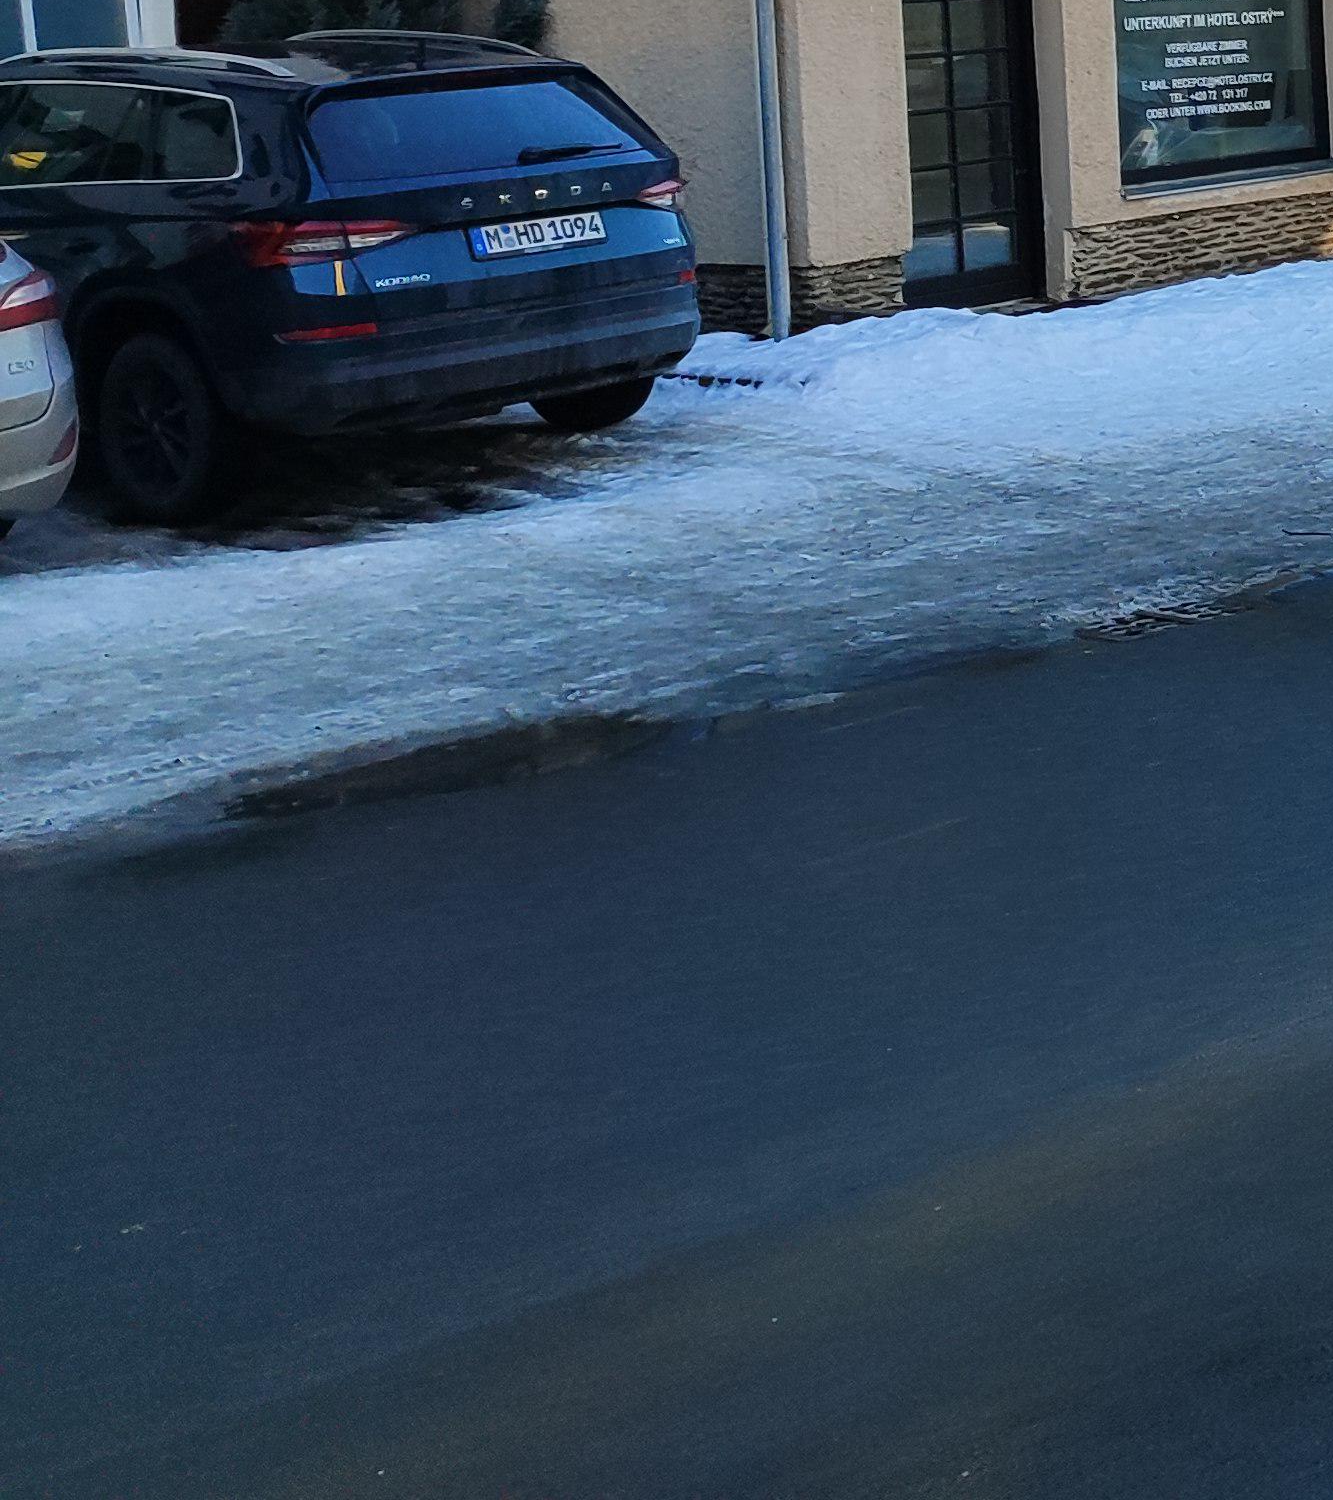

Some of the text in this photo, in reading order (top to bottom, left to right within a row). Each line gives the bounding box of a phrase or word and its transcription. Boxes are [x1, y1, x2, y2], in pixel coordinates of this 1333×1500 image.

[1123, 14, 1192, 32] UNTERKUNFT
[1207, 13, 1240, 29] HOTEL
[484, 214, 602, 250] M HD 1094
